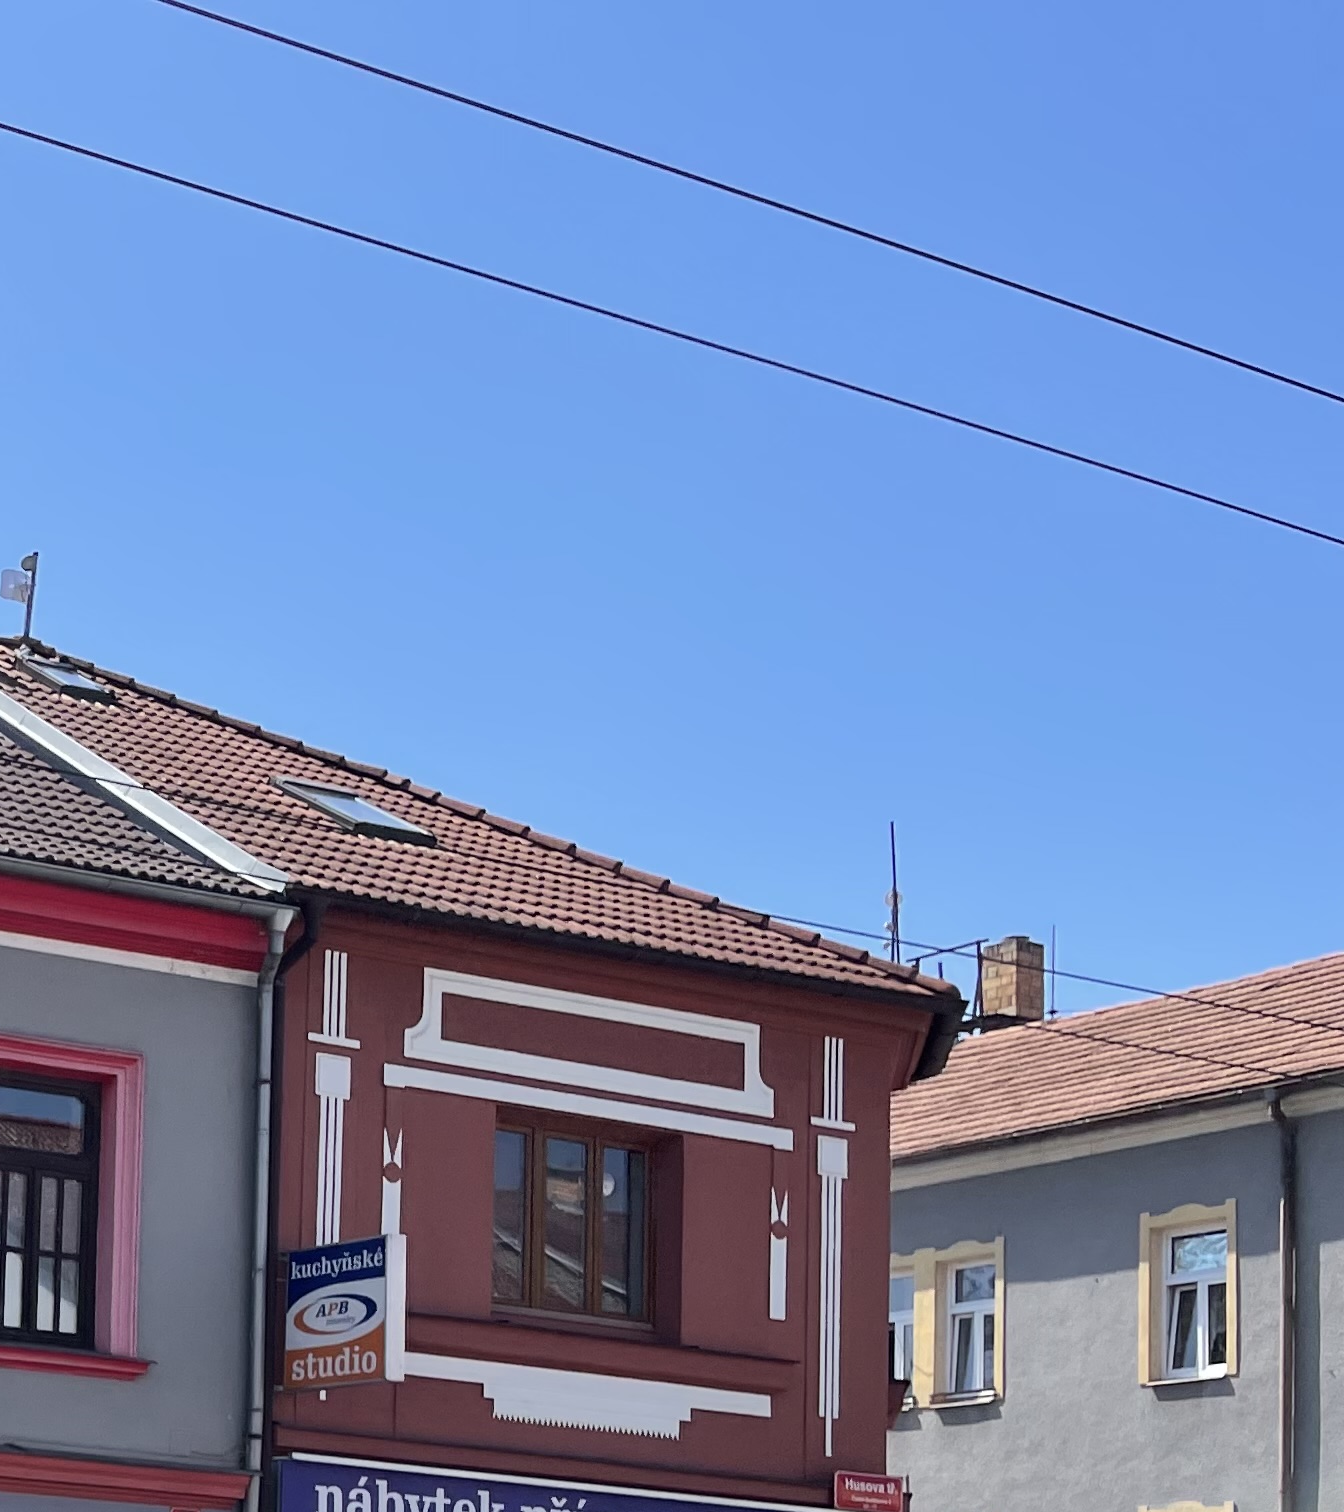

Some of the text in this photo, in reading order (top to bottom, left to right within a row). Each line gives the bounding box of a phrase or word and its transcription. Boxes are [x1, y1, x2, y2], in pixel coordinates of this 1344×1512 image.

[290, 1246, 384, 1280] kuchyňské
[315, 1300, 349, 1318] APB
[291, 1345, 377, 1381] studio
[845, 1477, 885, 1494] Husova
